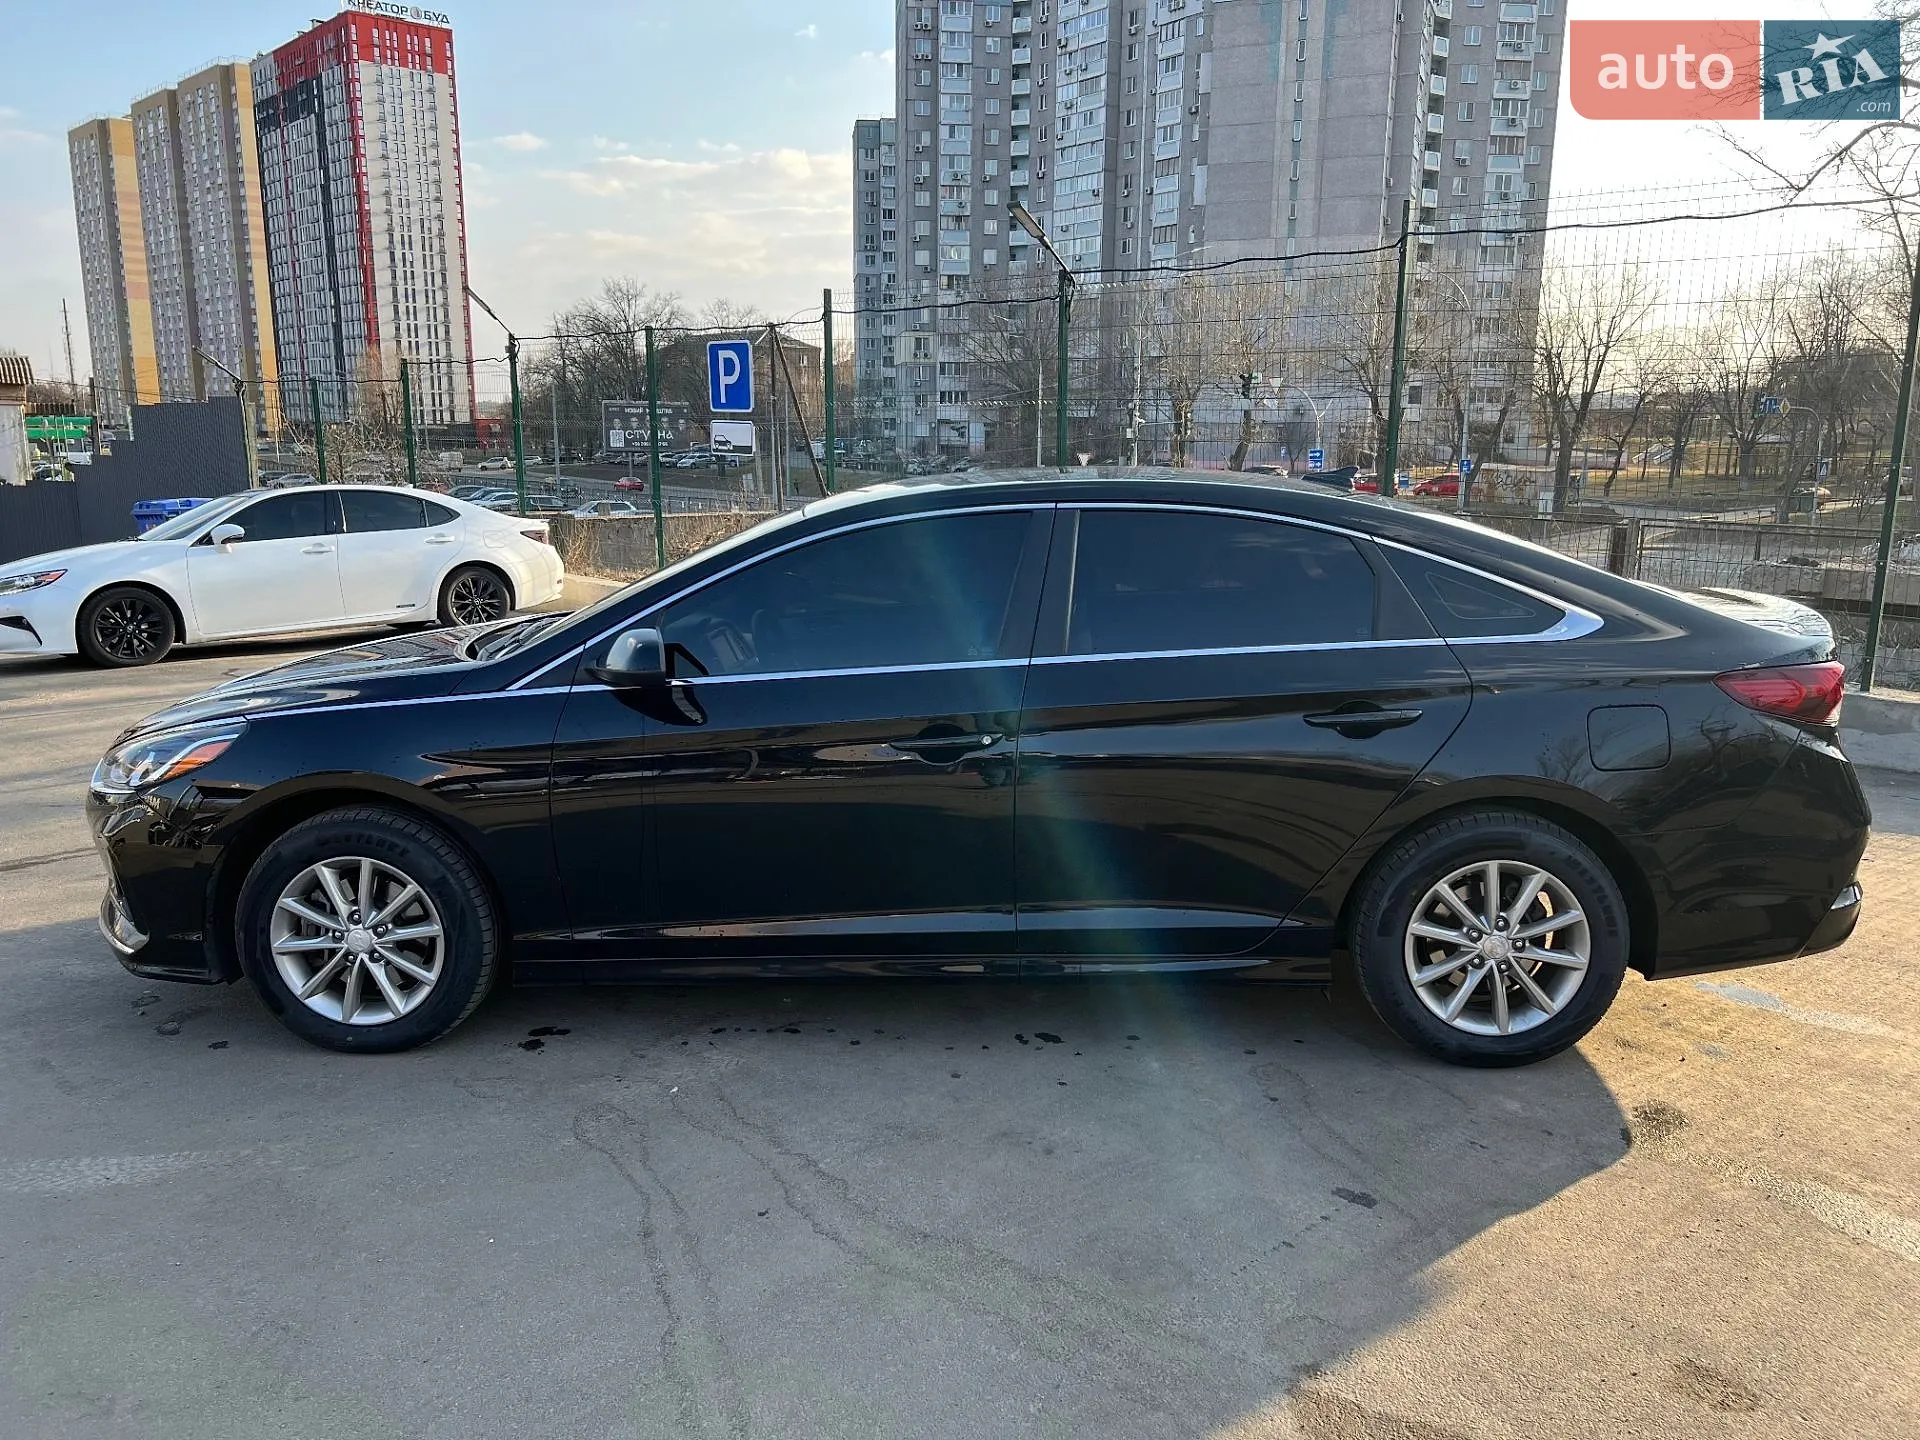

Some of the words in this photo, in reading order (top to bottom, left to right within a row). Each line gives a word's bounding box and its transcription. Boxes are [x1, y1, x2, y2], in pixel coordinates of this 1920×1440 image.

[424, 10, 450, 24] БУД
[718, 349, 741, 404] P
[625, 429, 674, 441] СТУНА
